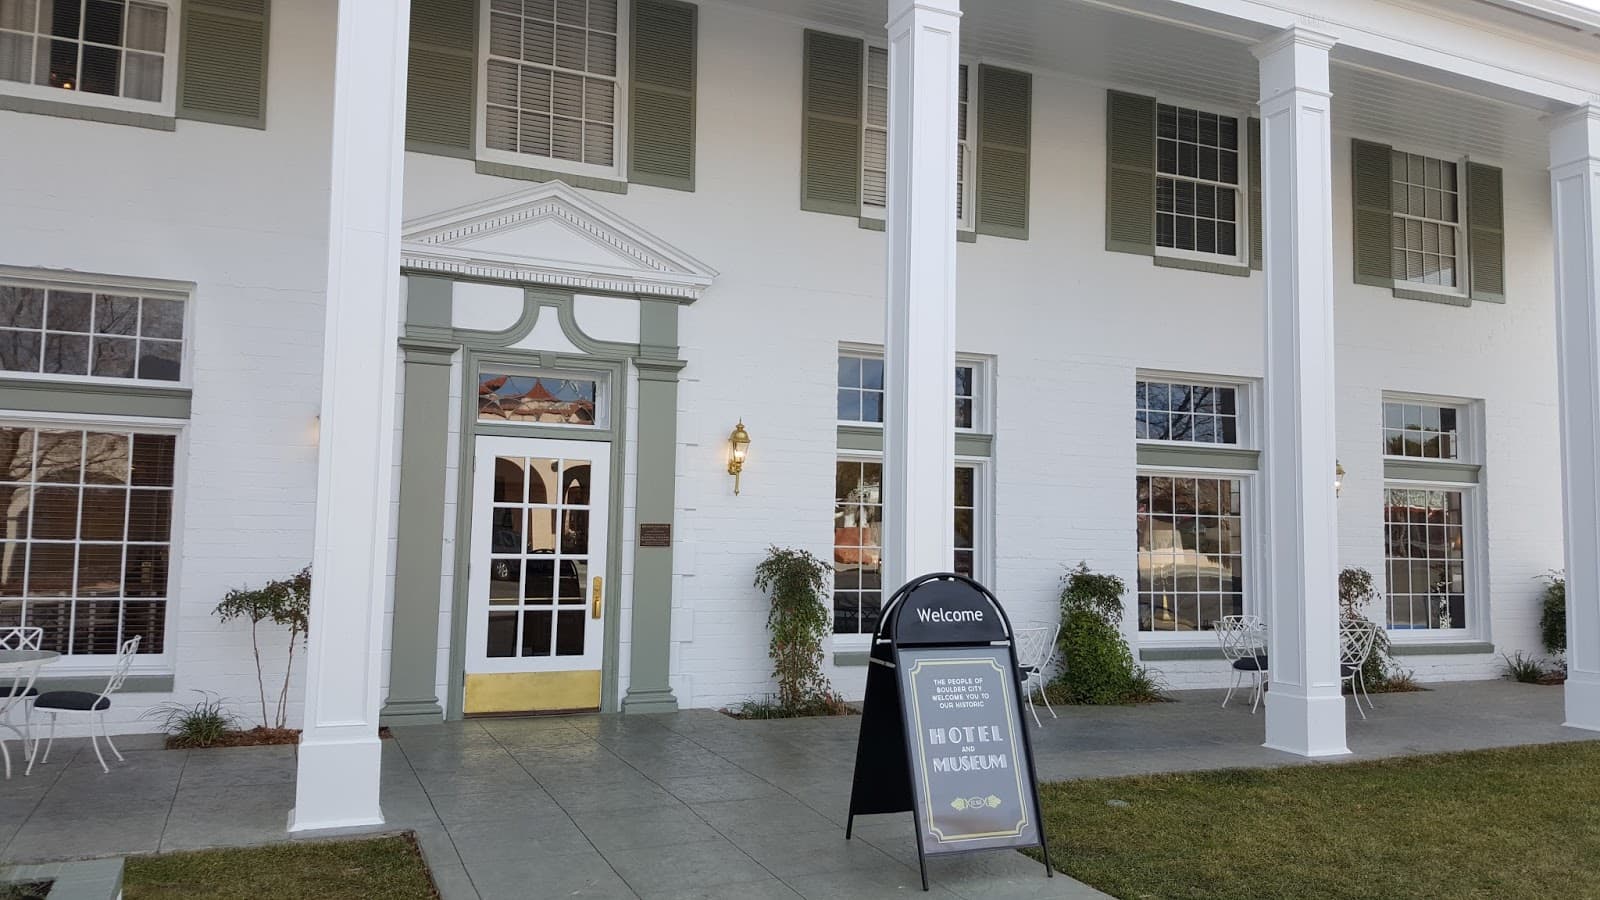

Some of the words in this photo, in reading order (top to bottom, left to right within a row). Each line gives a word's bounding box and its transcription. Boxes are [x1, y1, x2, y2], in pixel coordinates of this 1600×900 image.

[916, 607, 984, 623] Welcome
[928, 726, 1004, 745] HOTEL
[961, 745, 976, 753] AND
[932, 754, 1008, 773] MUSEUM
